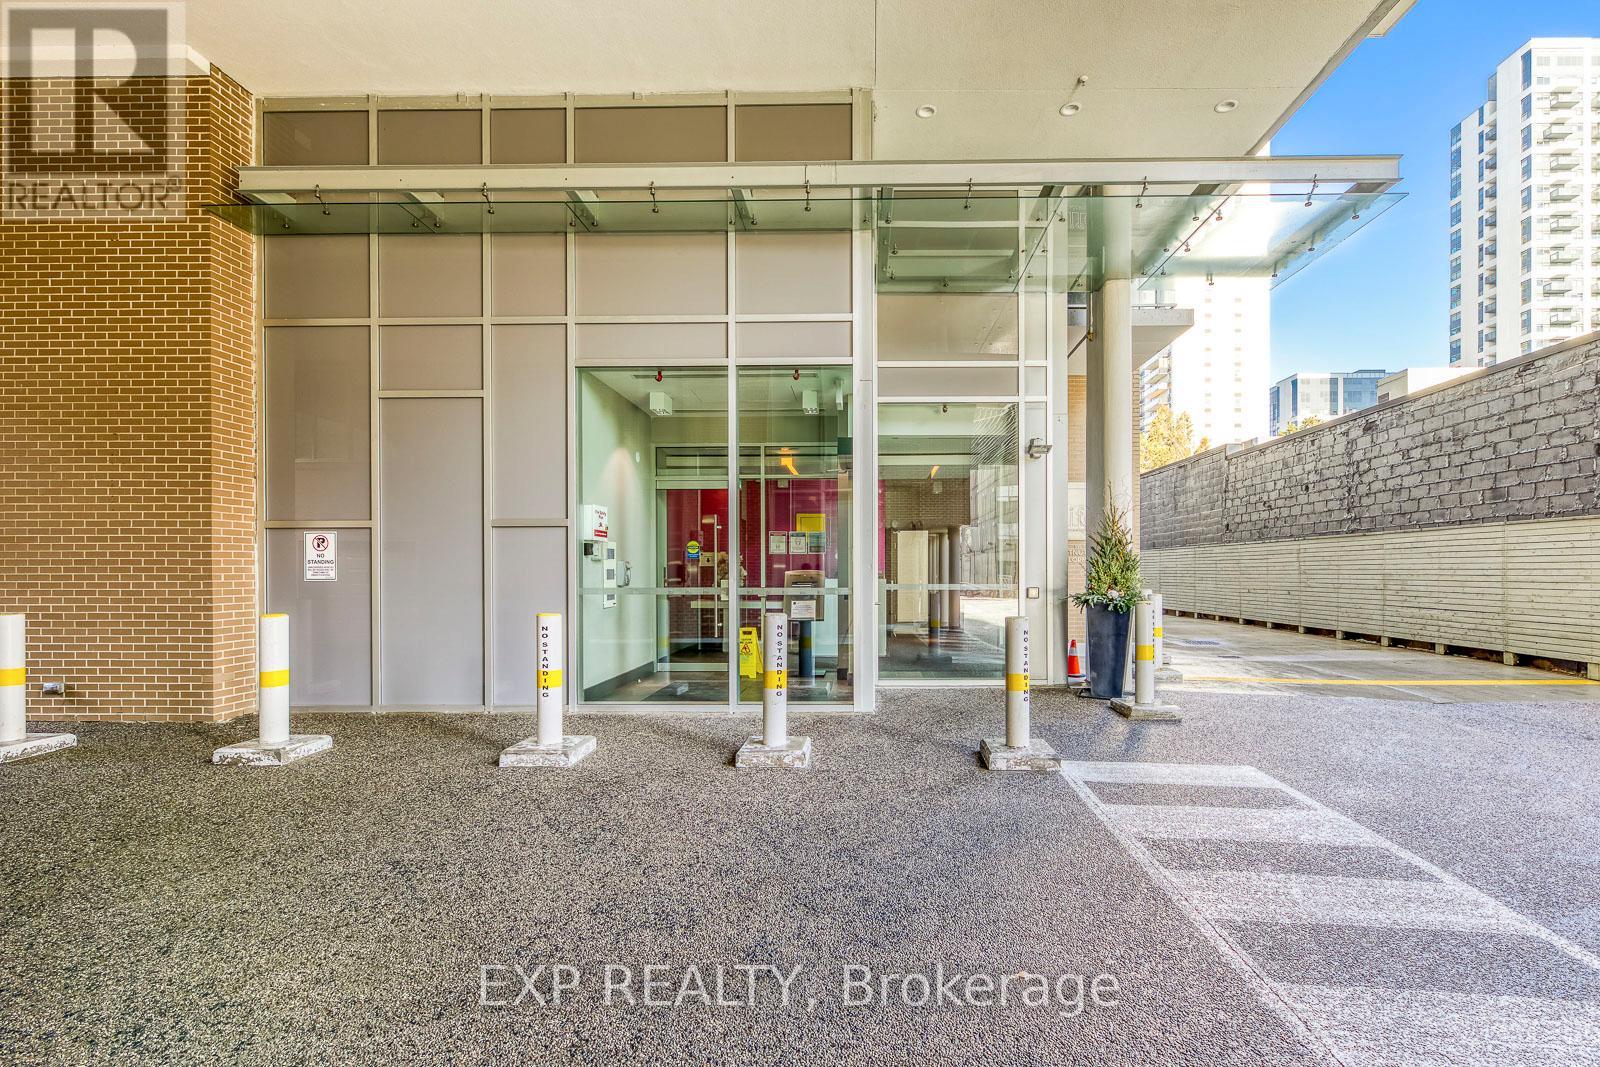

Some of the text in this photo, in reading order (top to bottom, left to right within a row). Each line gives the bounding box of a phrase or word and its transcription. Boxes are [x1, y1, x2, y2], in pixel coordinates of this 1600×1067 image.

[776, 624, 783, 638] NO
[1023, 630, 1029, 643] NO
[541, 626, 550, 698] NO STANDING
